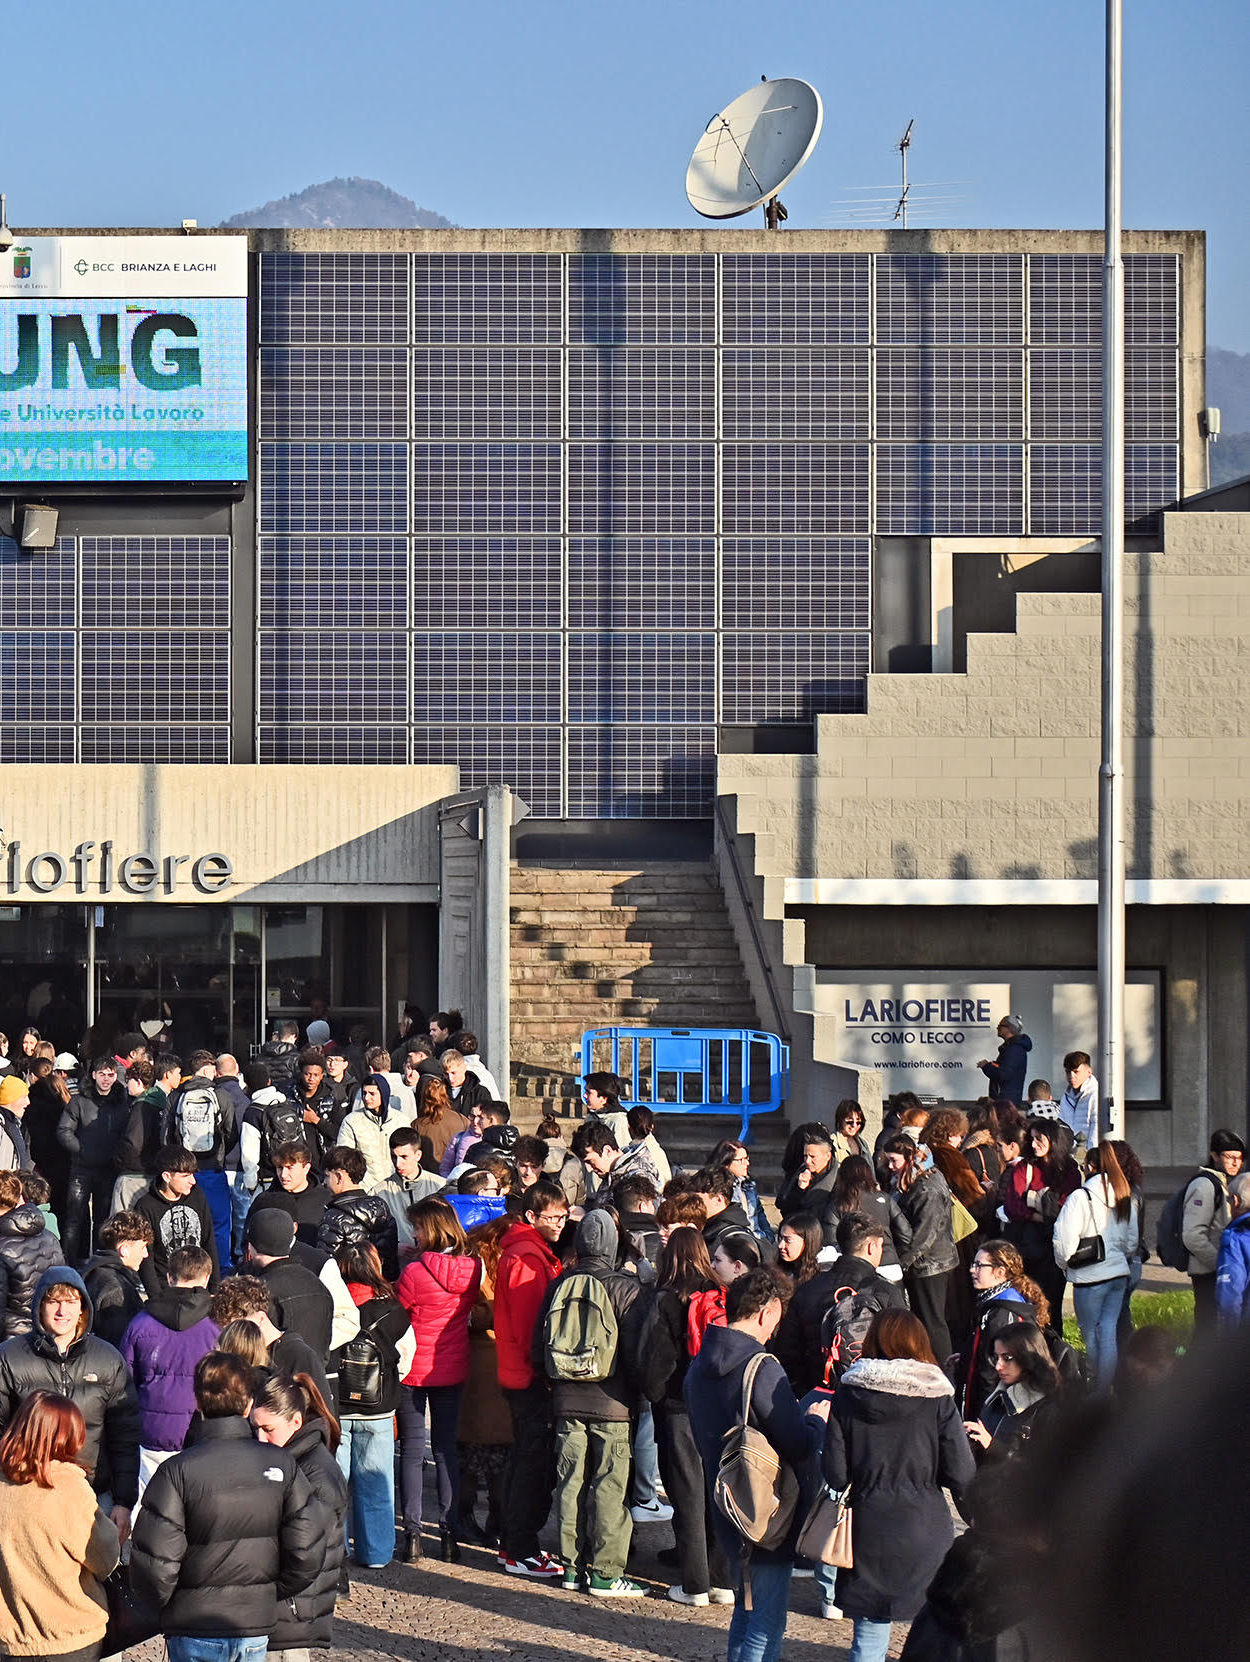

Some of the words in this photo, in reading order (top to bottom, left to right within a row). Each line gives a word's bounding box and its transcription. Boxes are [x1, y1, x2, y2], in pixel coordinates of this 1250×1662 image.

[92, 263, 115, 272] BCC
[121, 263, 171, 272] BRIANZA
[174, 263, 180, 272] E
[183, 263, 217, 272] LAGHI
[17, 403, 125, 422] Università
[131, 403, 205, 422] Lavoro
[845, 999, 991, 1023] LARIOFIERE
[871, 1032, 916, 1044] COMO
[919, 1032, 965, 1044] LECCO
[874, 1059, 963, 1070] www.lariofiere.com
